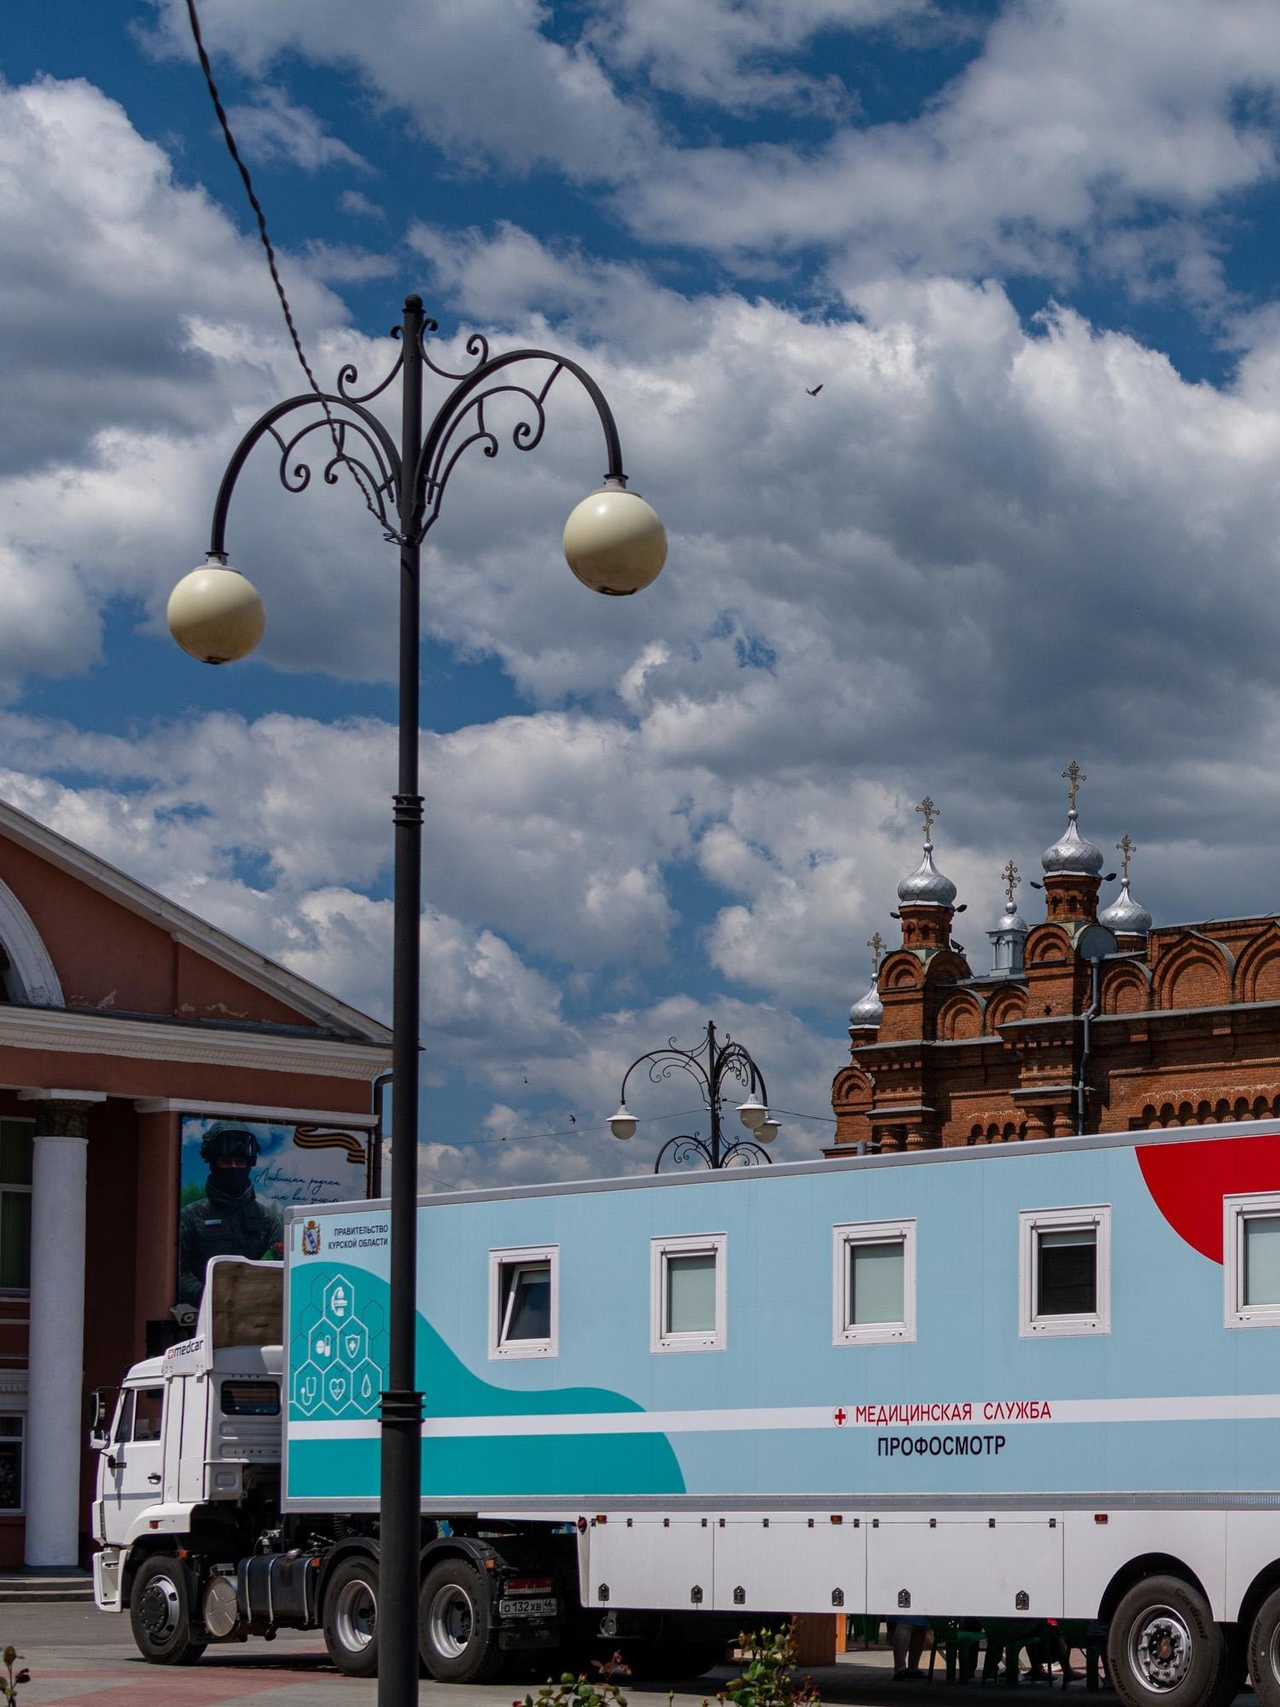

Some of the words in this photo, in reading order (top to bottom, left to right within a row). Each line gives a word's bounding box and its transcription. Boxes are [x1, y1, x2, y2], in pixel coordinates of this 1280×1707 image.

[334, 1225, 388, 1236] ПРАВИТЕЛЬСТВО
[328, 1239, 357, 1249] КУРСКОЙ
[358, 1238, 388, 1248] ОБЛАСТИ
[175, 1340, 204, 1357] medcar
[856, 1403, 972, 1426] МЕДИЦИНСКАЯ
[983, 1401, 1052, 1420] СЛУЖБА
[877, 1435, 1006, 1456] ПРОФОСМОТР
